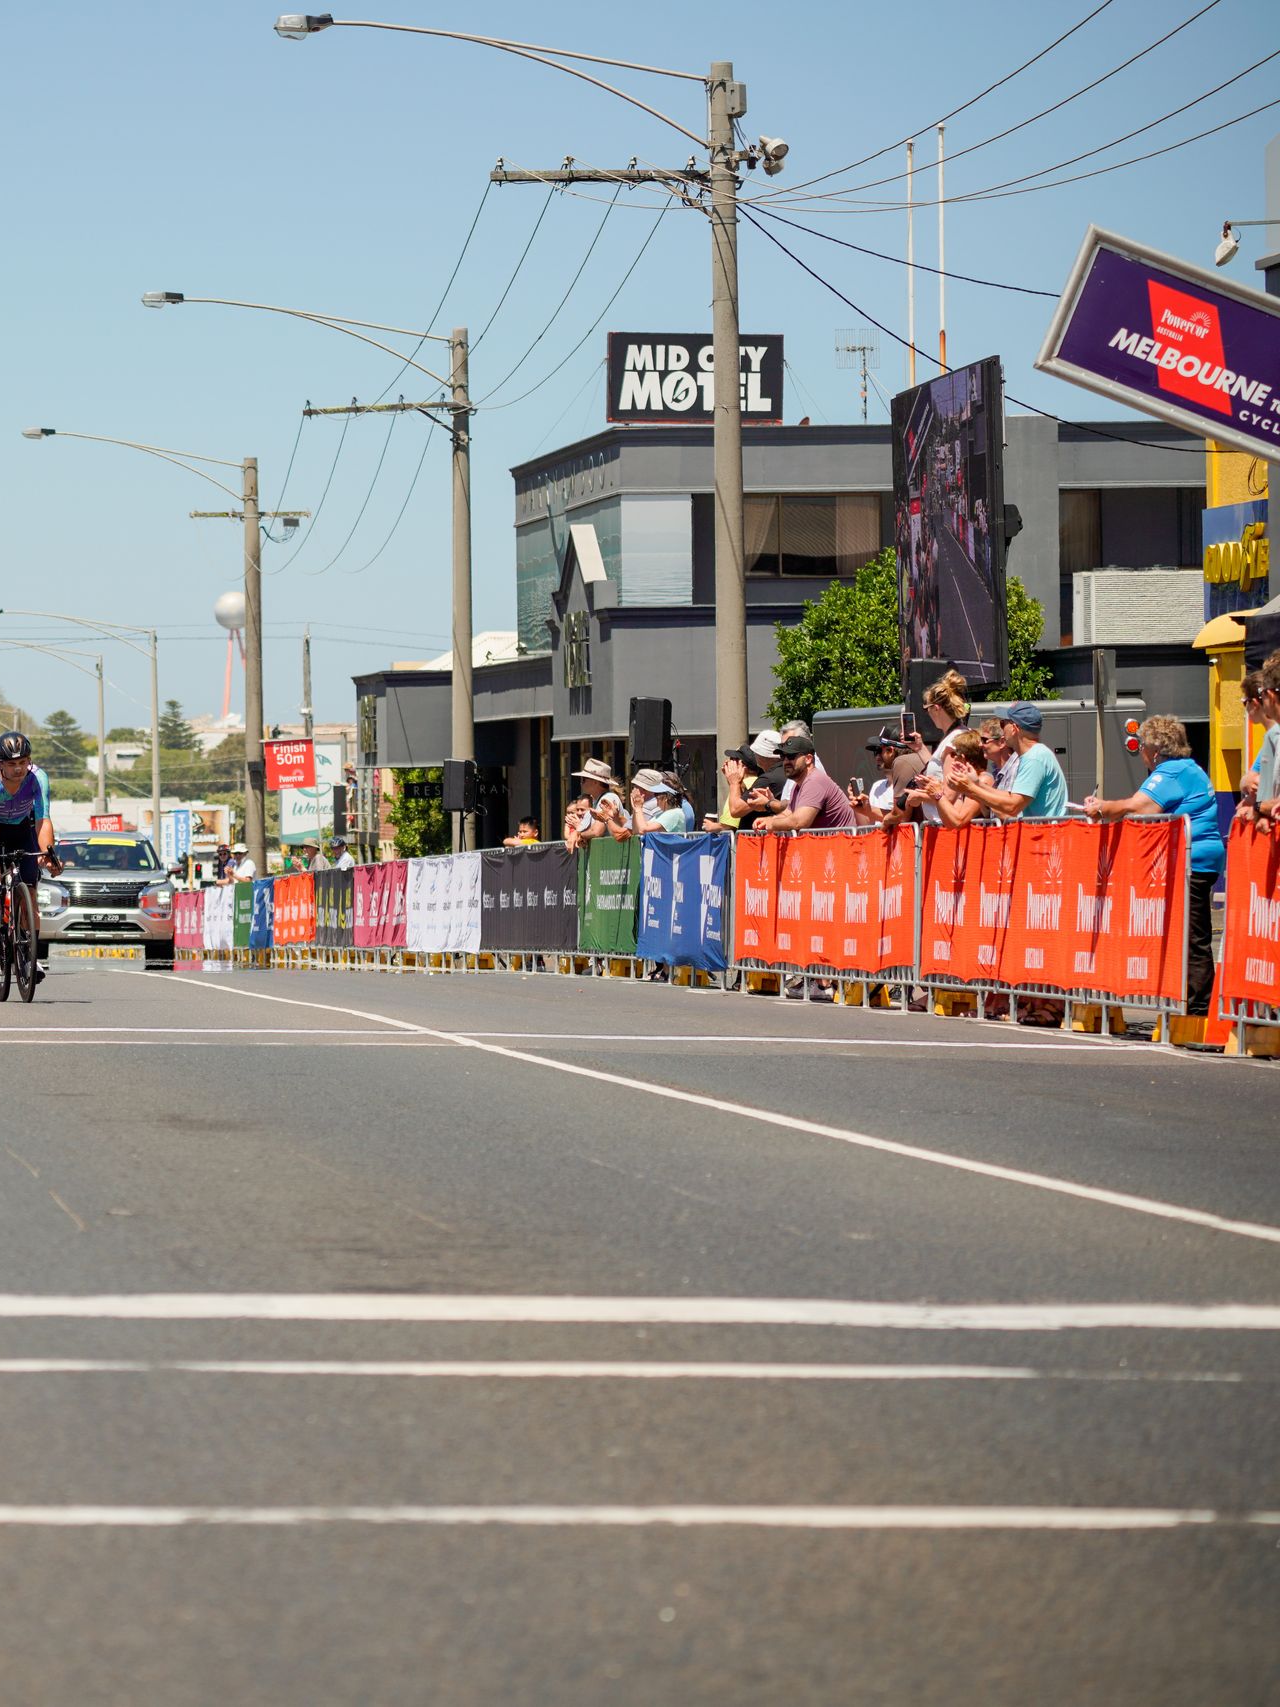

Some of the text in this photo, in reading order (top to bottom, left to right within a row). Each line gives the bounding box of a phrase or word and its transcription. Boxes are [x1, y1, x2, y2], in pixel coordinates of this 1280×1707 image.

[1161, 308, 1209, 339] Powercor
[624, 344, 690, 371] MID
[1108, 327, 1272, 407] MELBOURNE
[618, 371, 772, 412] MOTL
[1238, 410, 1280, 435] CYCL
[273, 743, 307, 755] Finish
[276, 754, 305, 766] 50m
[95, 823, 120, 831] 100m
[1026, 882, 1062, 931] Powercor
[1076, 882, 1113, 934] Powercor
[1128, 885, 1166, 937] Powercor
[1247, 881, 1280, 942] Power
[1244, 956, 1275, 987] AUSTRALIA
